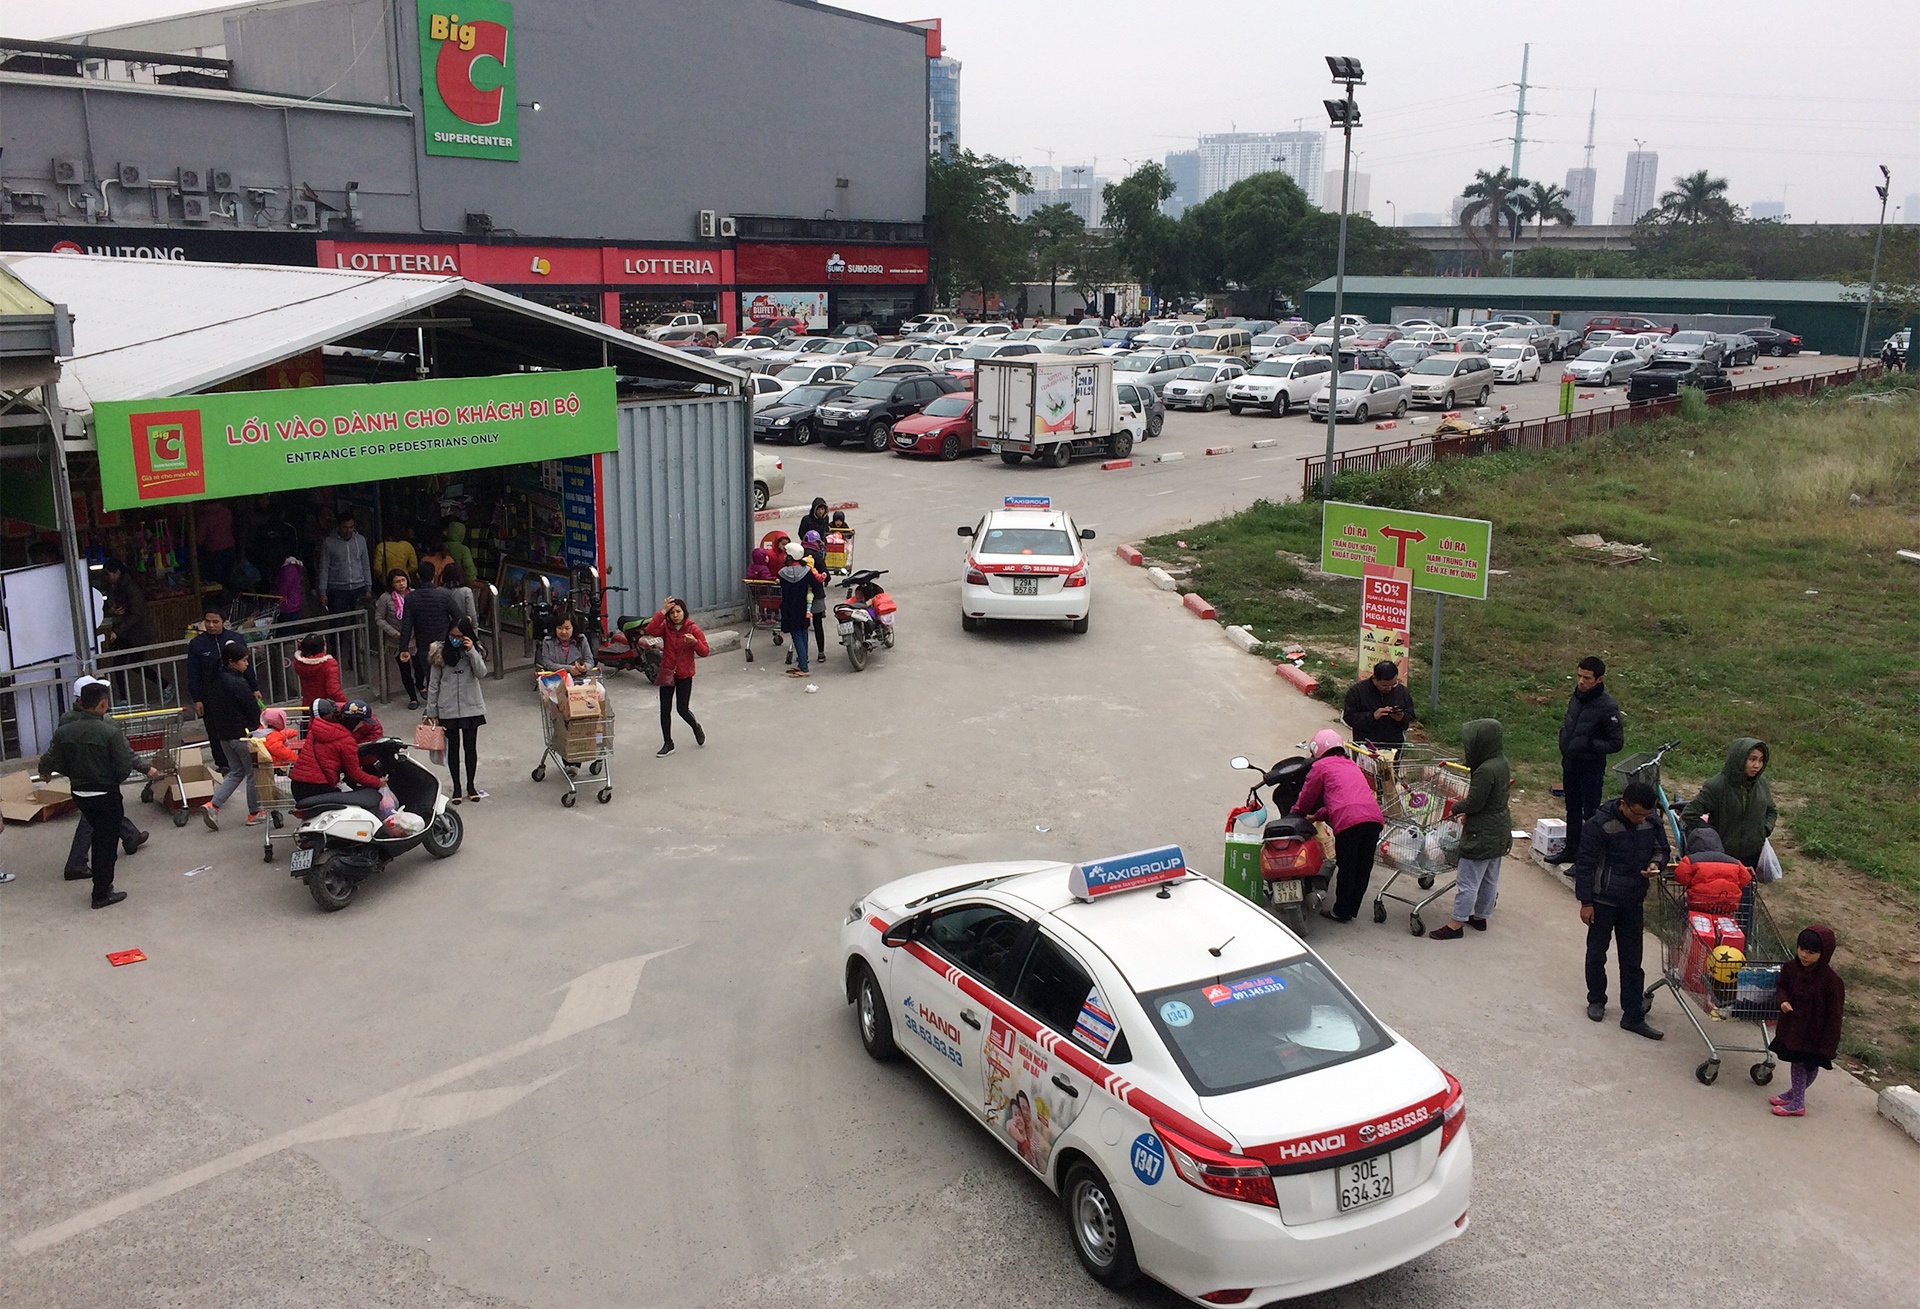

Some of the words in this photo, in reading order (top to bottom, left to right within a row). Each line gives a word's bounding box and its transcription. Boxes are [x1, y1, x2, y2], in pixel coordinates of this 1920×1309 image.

[430, 14, 476, 50] Big
[436, 20, 508, 126] C
[434, 132, 513, 147] SUPERCENTER
[337, 253, 457, 271] LOTTERIA
[625, 259, 714, 274] LOTTERIA
[848, 264, 868, 273] SUMO
[868, 264, 884, 274] BBQ
[226, 416, 270, 446] LỐI
[276, 414, 328, 441] VÀO
[333, 410, 398, 436] DÀNH
[404, 408, 450, 429] CHO
[456, 400, 524, 425] KHÁCH
[528, 400, 548, 418] ĐI
[554, 392, 580, 417] BỘ
[152, 430, 169, 440] Big
[286, 447, 356, 464] ENTRANCE
[360, 444, 386, 456] FOR
[389, 437, 468, 453] PEDESTRIANS
[471, 433, 499, 446] ONLY
[1343, 523, 1355, 536] LỐI
[1357, 527, 1368, 538] RA
[1439, 537, 1452, 550] LỐI
[1454, 542, 1466, 552] RA
[1426, 553, 1441, 563] NAM
[1442, 556, 1463, 566] TRUNG
[1464, 556, 1478, 569] YÊN
[1440, 566, 1448, 575] XE
[1020, 578, 1031, 586] 29A
[1366, 603, 1406, 616] FASHION
[1366, 612, 1386, 621] MEGA
[1387, 616, 1405, 624] SALE
[1098, 857, 1180, 884] TAXIGROUP
[1233, 982, 1284, 1000] 091.345.5353
[919, 1003, 960, 1046] HANOI
[1167, 1009, 1188, 1022] 1347
[905, 1014, 962, 1068] 38.53.53.53
[1377, 1106, 1429, 1138] 38.53.53.53
[1148, 1136, 1155, 1146] 8
[1280, 1134, 1346, 1159] HANOI
[1134, 1147, 1160, 1179] 1347
[1351, 1158, 1378, 1184] 30E
[1342, 1176, 1391, 1208] 634.32
